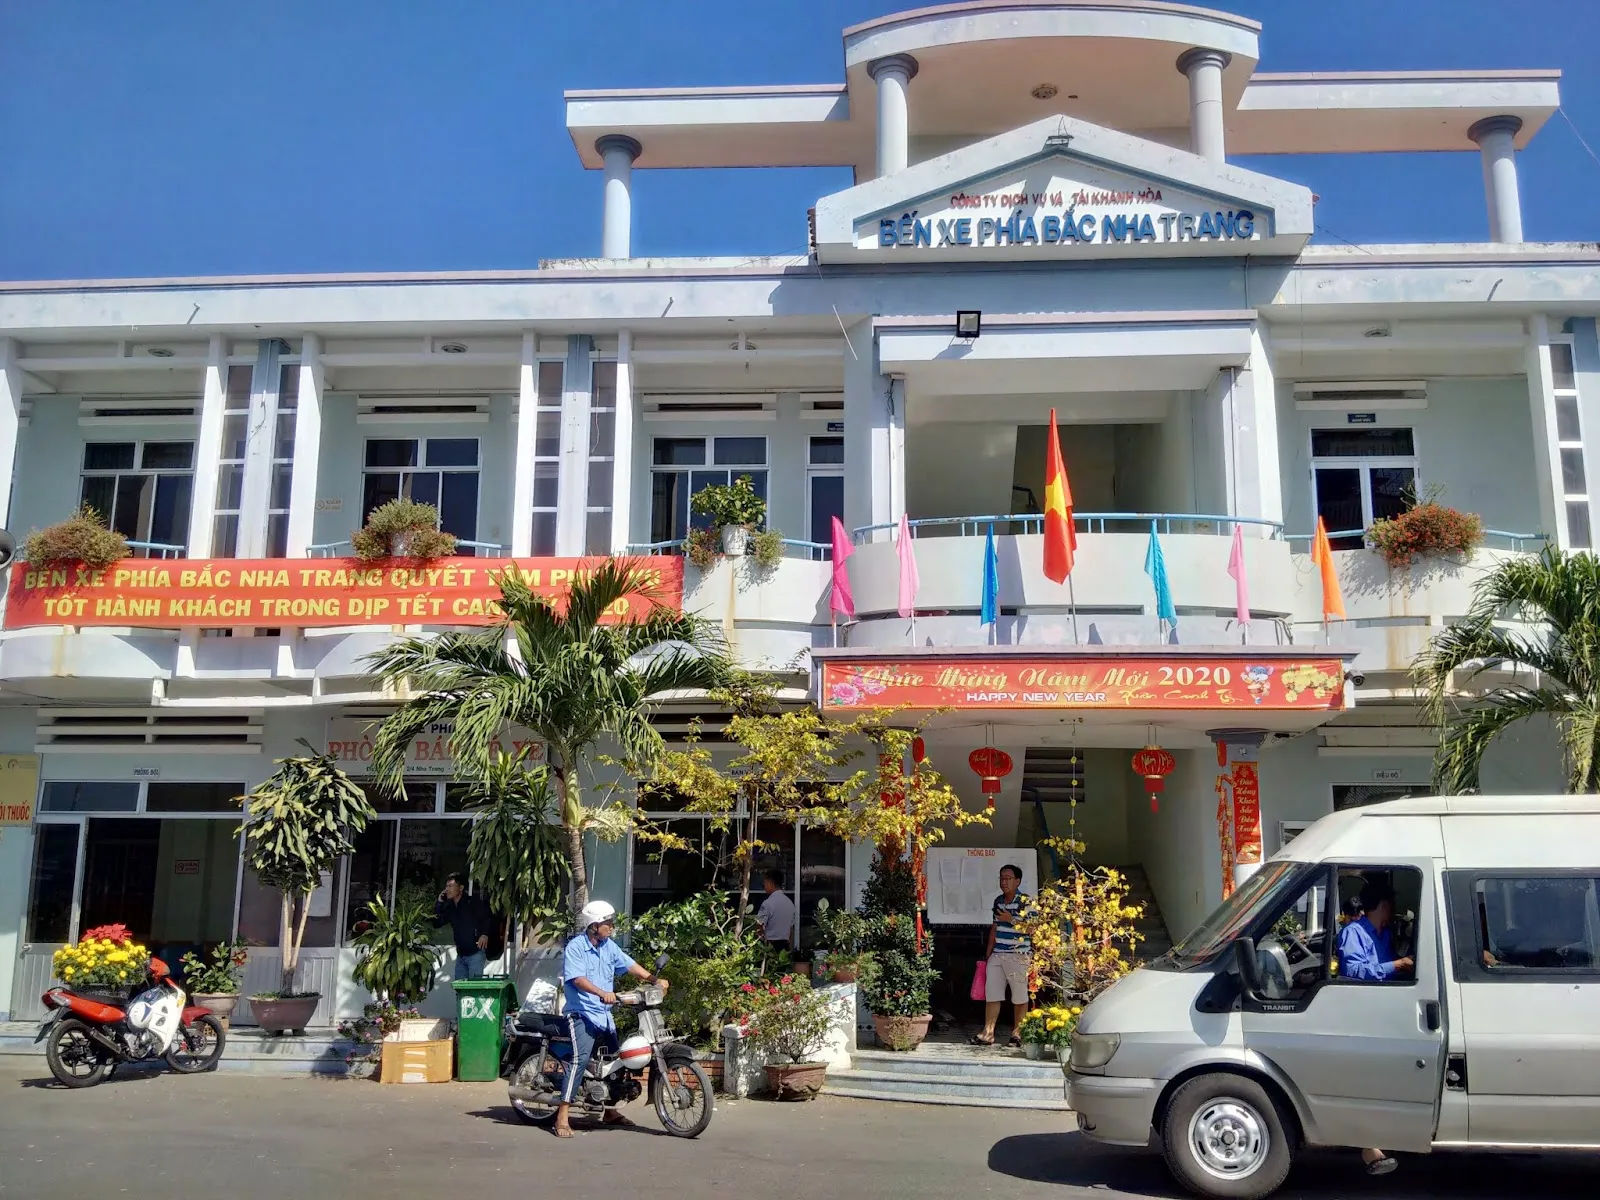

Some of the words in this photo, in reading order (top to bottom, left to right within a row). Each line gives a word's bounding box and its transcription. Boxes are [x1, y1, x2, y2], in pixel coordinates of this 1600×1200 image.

[983, 195, 998, 208] TY
[1001, 193, 1028, 209] DỊCH
[879, 211, 932, 246] BẾN
[936, 218, 972, 246] XE
[977, 209, 1038, 245] PHÍA
[1041, 203, 1097, 243] BẮC
[1101, 213, 1156, 241] NHA
[1157, 210, 1254, 240] TRANG
[75, 569, 104, 587] XE
[114, 565, 171, 587] PHÍA
[180, 563, 231, 587] BẮC
[239, 569, 290, 587] NHA
[300, 569, 383, 587] TRANG
[391, 562, 476, 589] QUYẾT
[44, 592, 88, 617] TỐT
[96, 595, 161, 617] HÀNH
[169, 595, 251, 617] KHÁCH
[260, 598, 340, 617] TRONG
[348, 598, 389, 619] DỊP
[397, 592, 444, 616] TẾT
[1018, 667, 1087, 687] Năm
[1096, 667, 1149, 687] Mới
[1158, 666, 1231, 686] 2020
[966, 692, 1018, 702] HAPPY
[1022, 692, 1059, 702] NEW
[1064, 692, 1107, 702] YEAR
[967, 848, 984, 857] THÔNG
[461, 995, 495, 1021] BX
